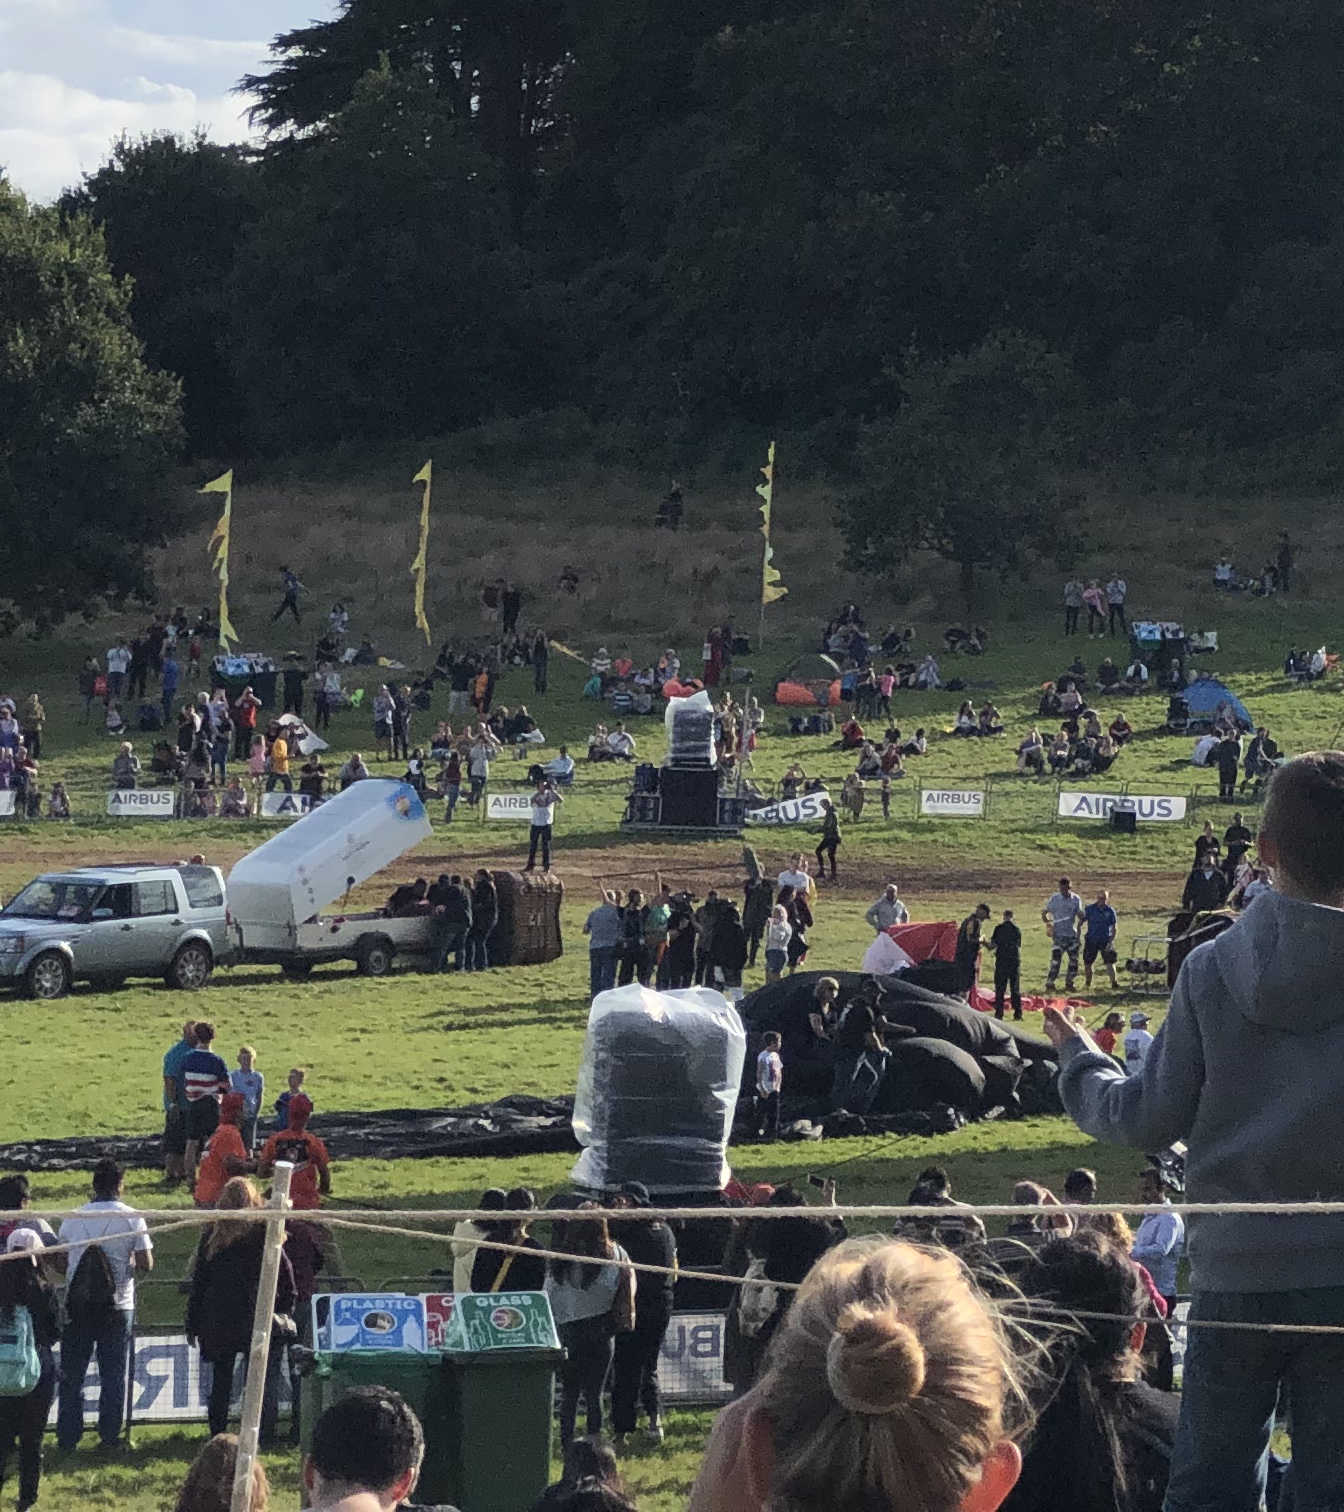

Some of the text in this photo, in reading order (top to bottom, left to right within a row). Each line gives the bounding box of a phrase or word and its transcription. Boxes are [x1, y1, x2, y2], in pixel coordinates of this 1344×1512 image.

[110, 793, 171, 805] AIRBUS
[491, 797, 533, 808] AIRB
[925, 792, 981, 804] AIRBUS
[341, 1298, 416, 1309] PLASTIC
[476, 1295, 532, 1306] GLASS
